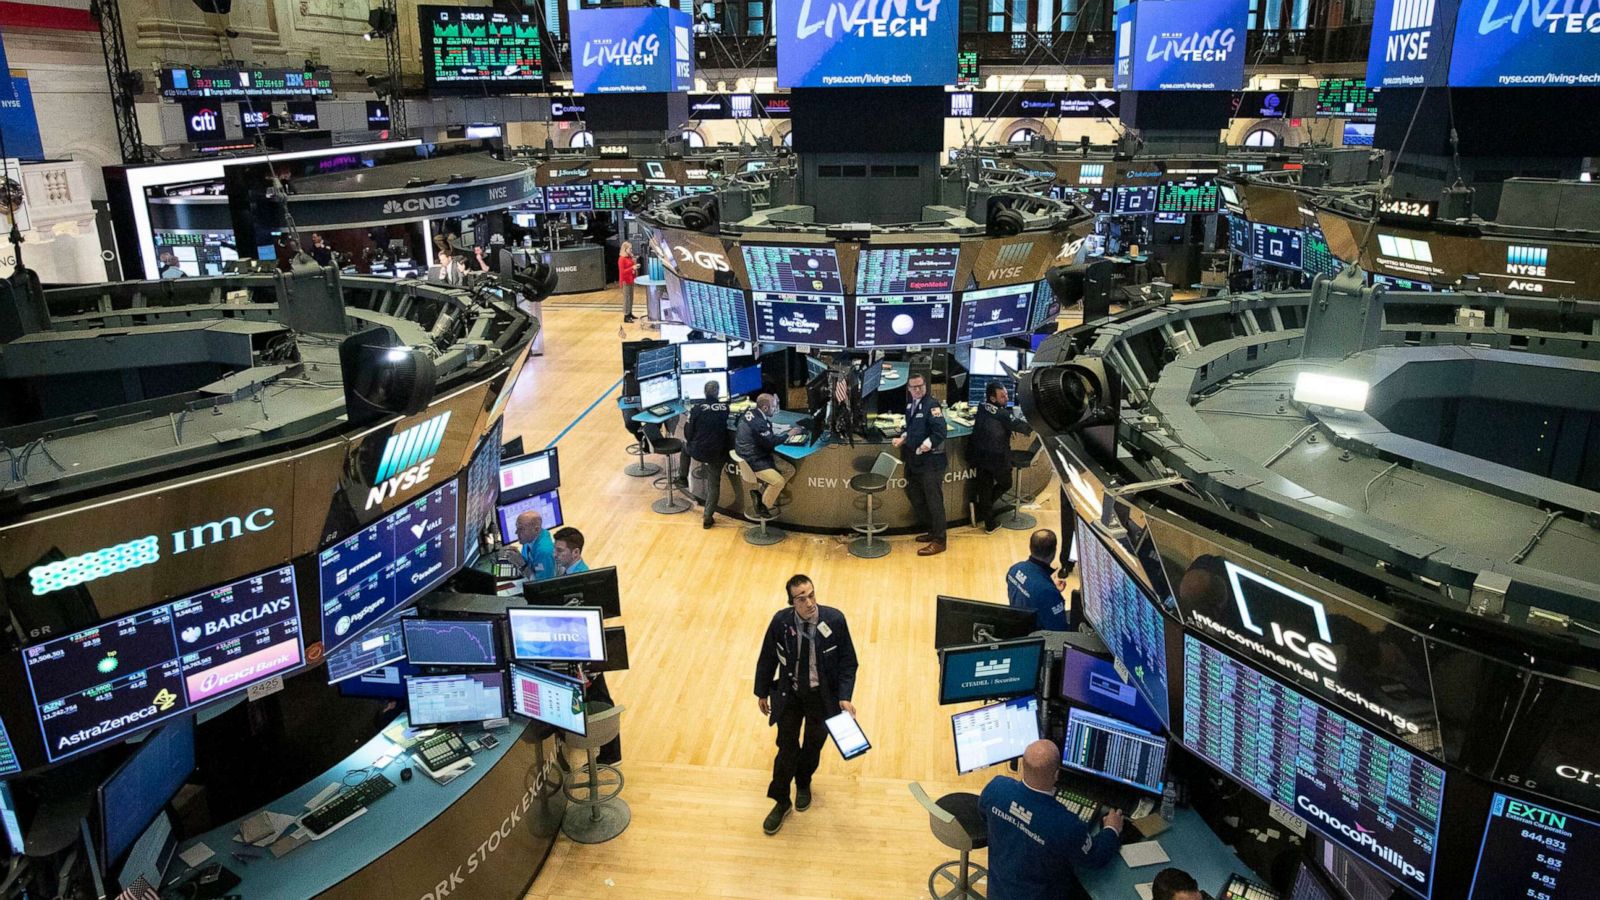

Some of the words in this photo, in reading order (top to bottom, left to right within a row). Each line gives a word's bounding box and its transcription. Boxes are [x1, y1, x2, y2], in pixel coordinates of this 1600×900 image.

[797, 0, 940, 39] LIVING
[854, 17, 928, 37] TECH
[582, 33, 660, 67] LIVING
[1146, 28, 1236, 62] LIVING
[1385, 31, 1430, 62] NYSE
[613, 53, 654, 66] TECH
[1181, 49, 1227, 62] TECH
[285, 73, 304, 87] IBM
[822, 73, 912, 86] nyse.com/living-tech
[1498, 73, 1600, 86] nyse.com/living-tech
[191, 112, 217, 131] citi
[731, 109, 752, 118] NYSE
[489, 186, 508, 201] NYSE
[402, 194, 460, 212] CNBC
[694, 251, 730, 272] GTS
[1506, 263, 1547, 278] NYSE
[986, 265, 1024, 281] NYSE
[1507, 279, 1544, 292] Arca
[364, 457, 435, 511] NYSE
[808, 477, 838, 488] NEW
[426, 517, 443, 532] VALE
[204, 596, 291, 636] BARCLAYS
[350, 596, 385, 623] PagSeguro
[107, 650, 117, 658] bp
[255, 654, 290, 673] Bank
[1192, 609, 1319, 683] Intercontinental
[1322, 676, 1420, 735] Exchange
[252, 677, 279, 695] 2425
[960, 679, 990, 689] CITADEL
[994, 676, 1021, 685] Securities
[43, 700, 61, 713] AZN
[58, 703, 158, 750] AstraZeneca
[467, 808, 521, 875] STOCK
[522, 749, 558, 813] EXCHA
[991, 805, 1017, 826] CITADEL
[1507, 800, 1567, 829] EXTN
[1505, 812, 1533, 826] Exterran
[1533, 820, 1573, 838] Corporation
[1296, 794, 1426, 883] ConocoPhillips
[1520, 829, 1567, 851] 844,831
[1531, 871, 1557, 886] 8.81
[1526, 888, 1551, 900] 5.51
